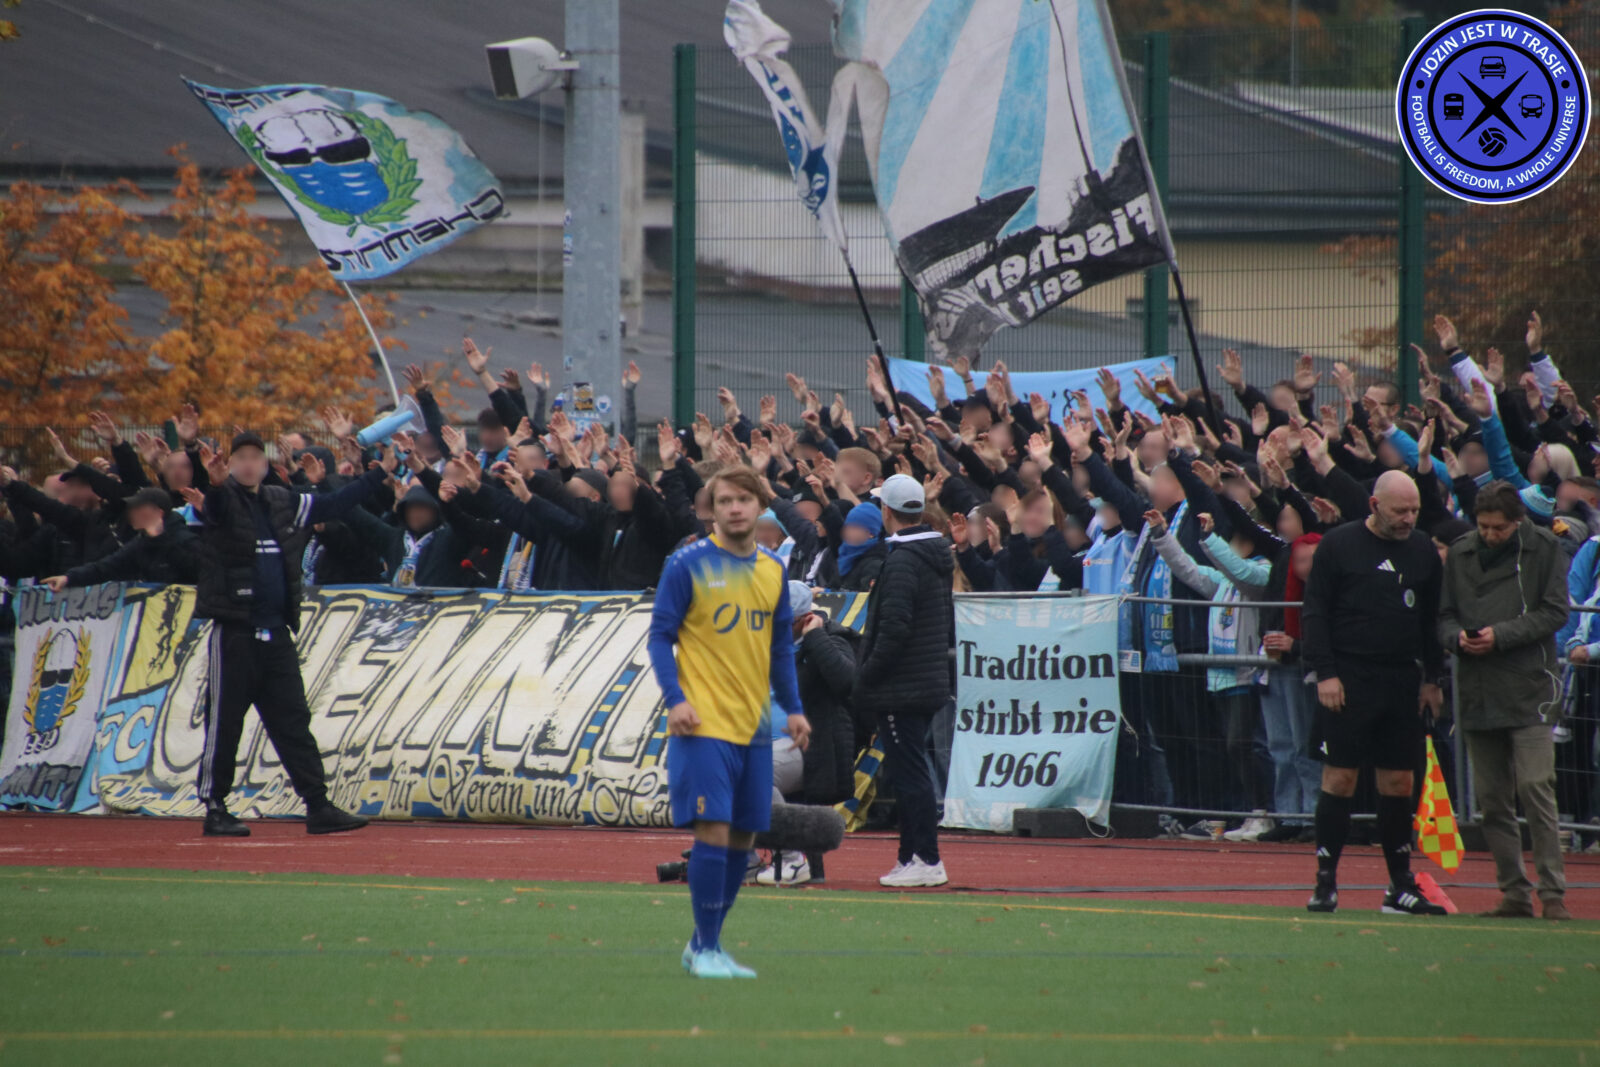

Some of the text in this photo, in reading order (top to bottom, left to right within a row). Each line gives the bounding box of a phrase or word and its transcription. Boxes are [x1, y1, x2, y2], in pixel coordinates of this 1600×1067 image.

[19, 581, 121, 629] ULTRAS
[958, 640, 1115, 681] Tradition
[957, 697, 1117, 736] stirbt nie
[428, 753, 526, 814] Verein
[533, 765, 590, 820] und
[975, 751, 1062, 788] 1966
[697, 796, 706, 815] 5
